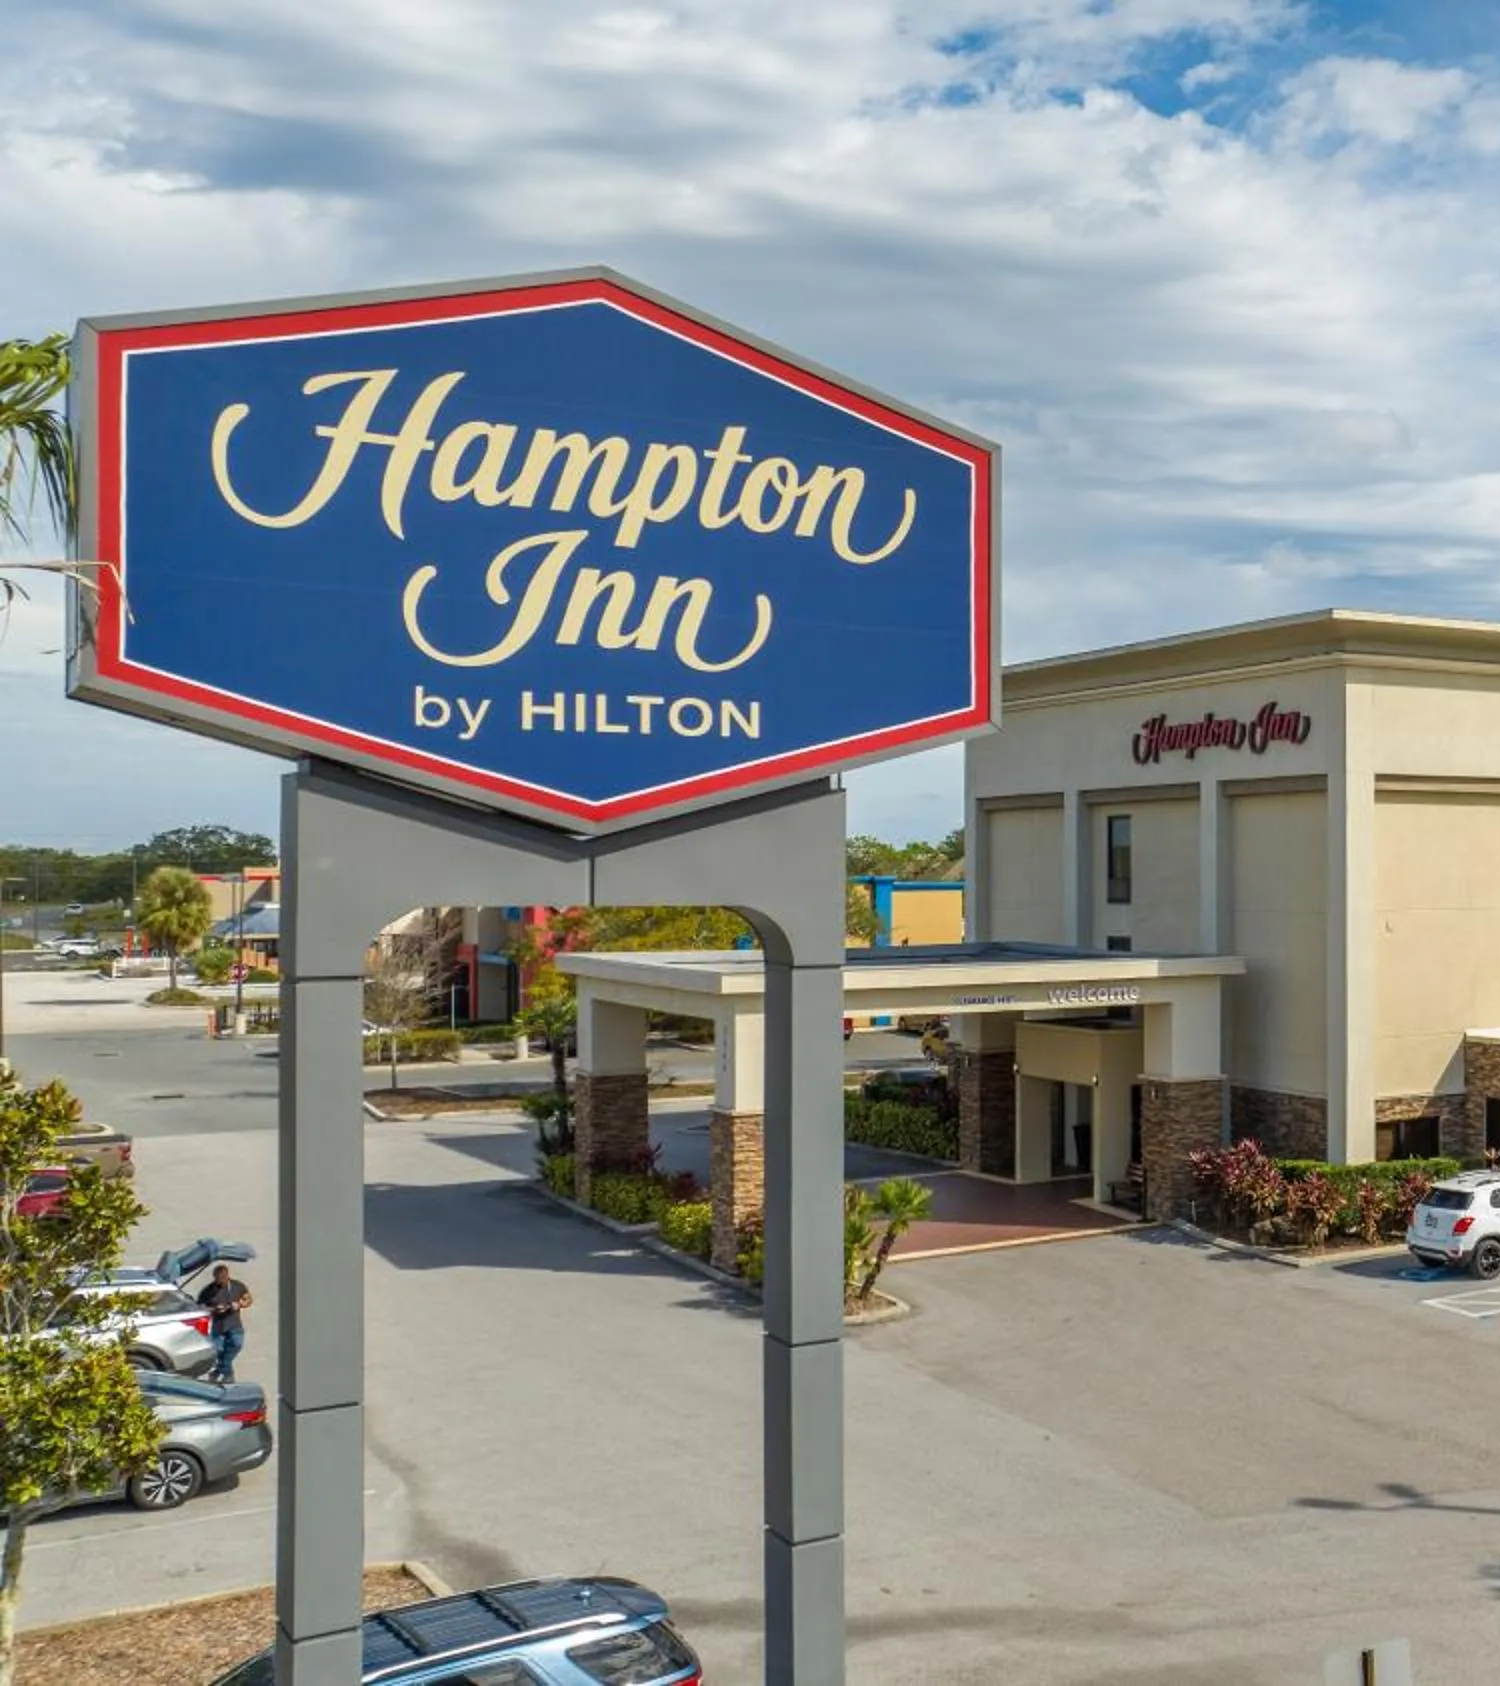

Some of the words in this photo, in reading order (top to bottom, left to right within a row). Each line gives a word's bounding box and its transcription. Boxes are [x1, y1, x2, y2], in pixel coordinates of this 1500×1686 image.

[211, 369, 916, 564] Hampton
[402, 530, 772, 671] Inn
[415, 685, 491, 740] by
[521, 691, 761, 739] HILTON
[1132, 713, 1247, 766] Hampton
[1248, 701, 1311, 755] Inn
[1048, 984, 1140, 1004] welcome
